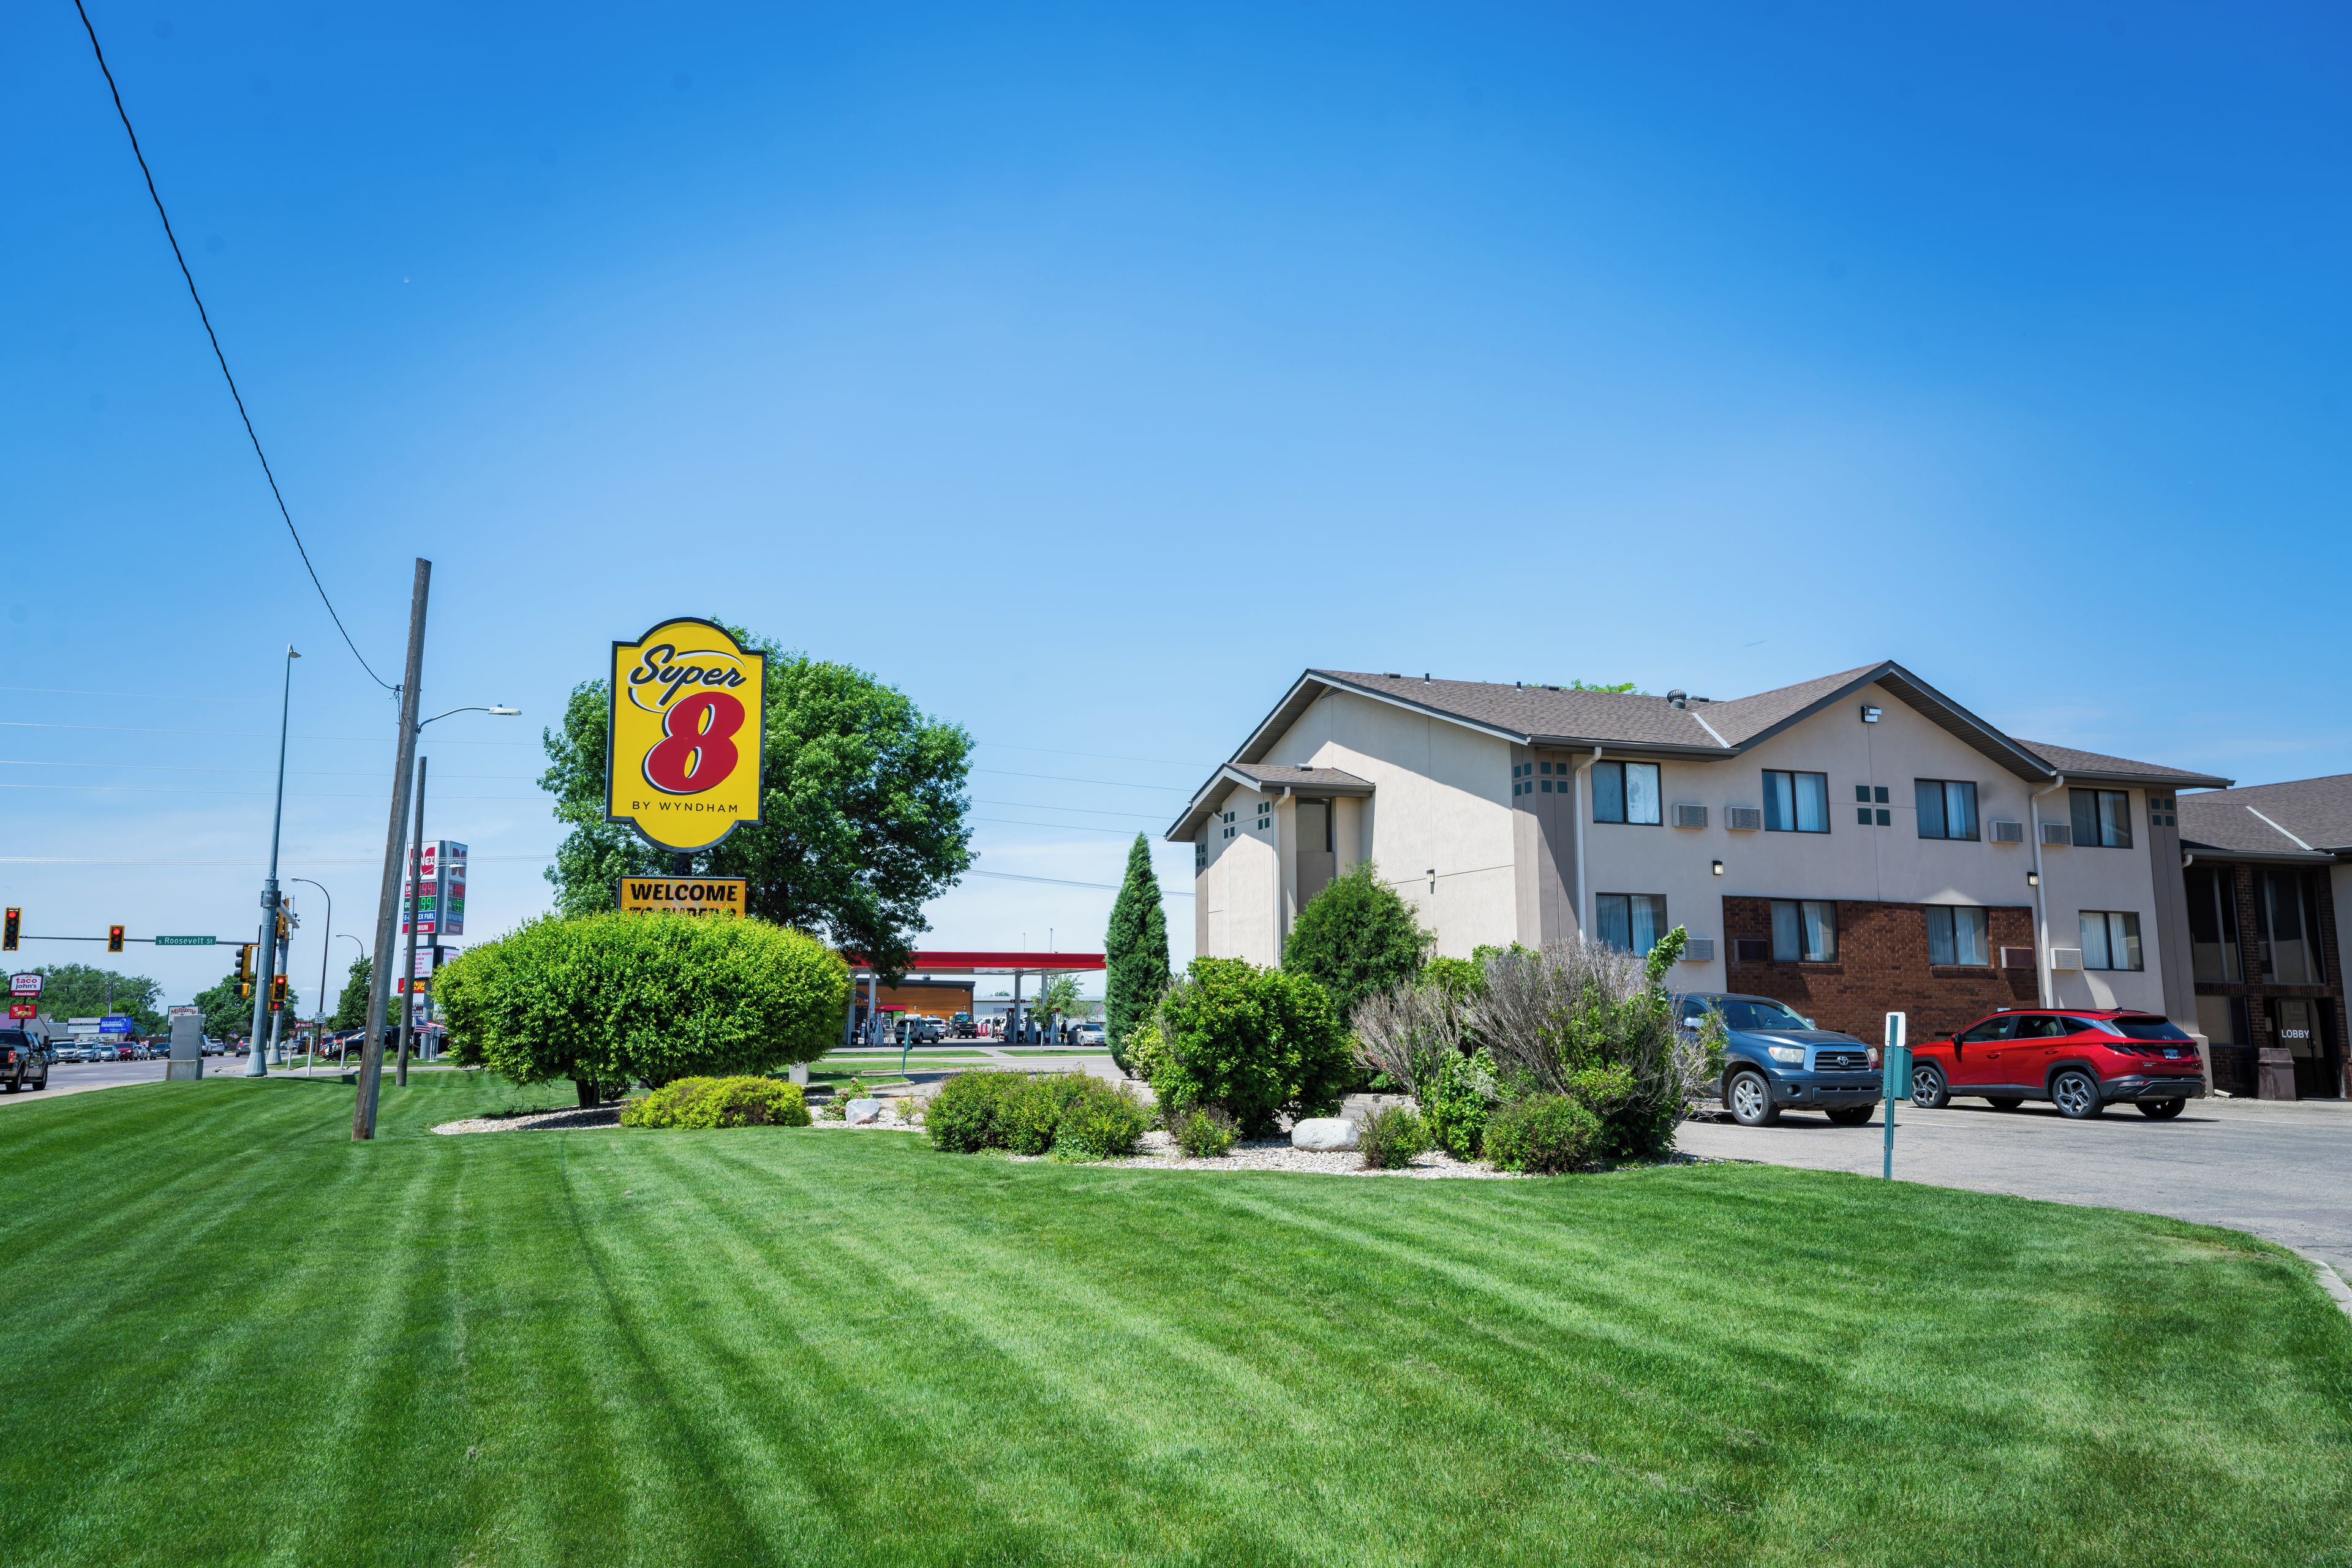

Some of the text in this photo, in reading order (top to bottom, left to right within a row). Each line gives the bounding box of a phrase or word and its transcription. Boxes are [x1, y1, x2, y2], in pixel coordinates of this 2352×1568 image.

[628, 644, 747, 707] Super
[641, 692, 745, 796] 8
[632, 801, 738, 813] BY WYNDHAM
[630, 884, 737, 901] WELCOME
[2282, 1030, 2309, 1038] LOBBY
